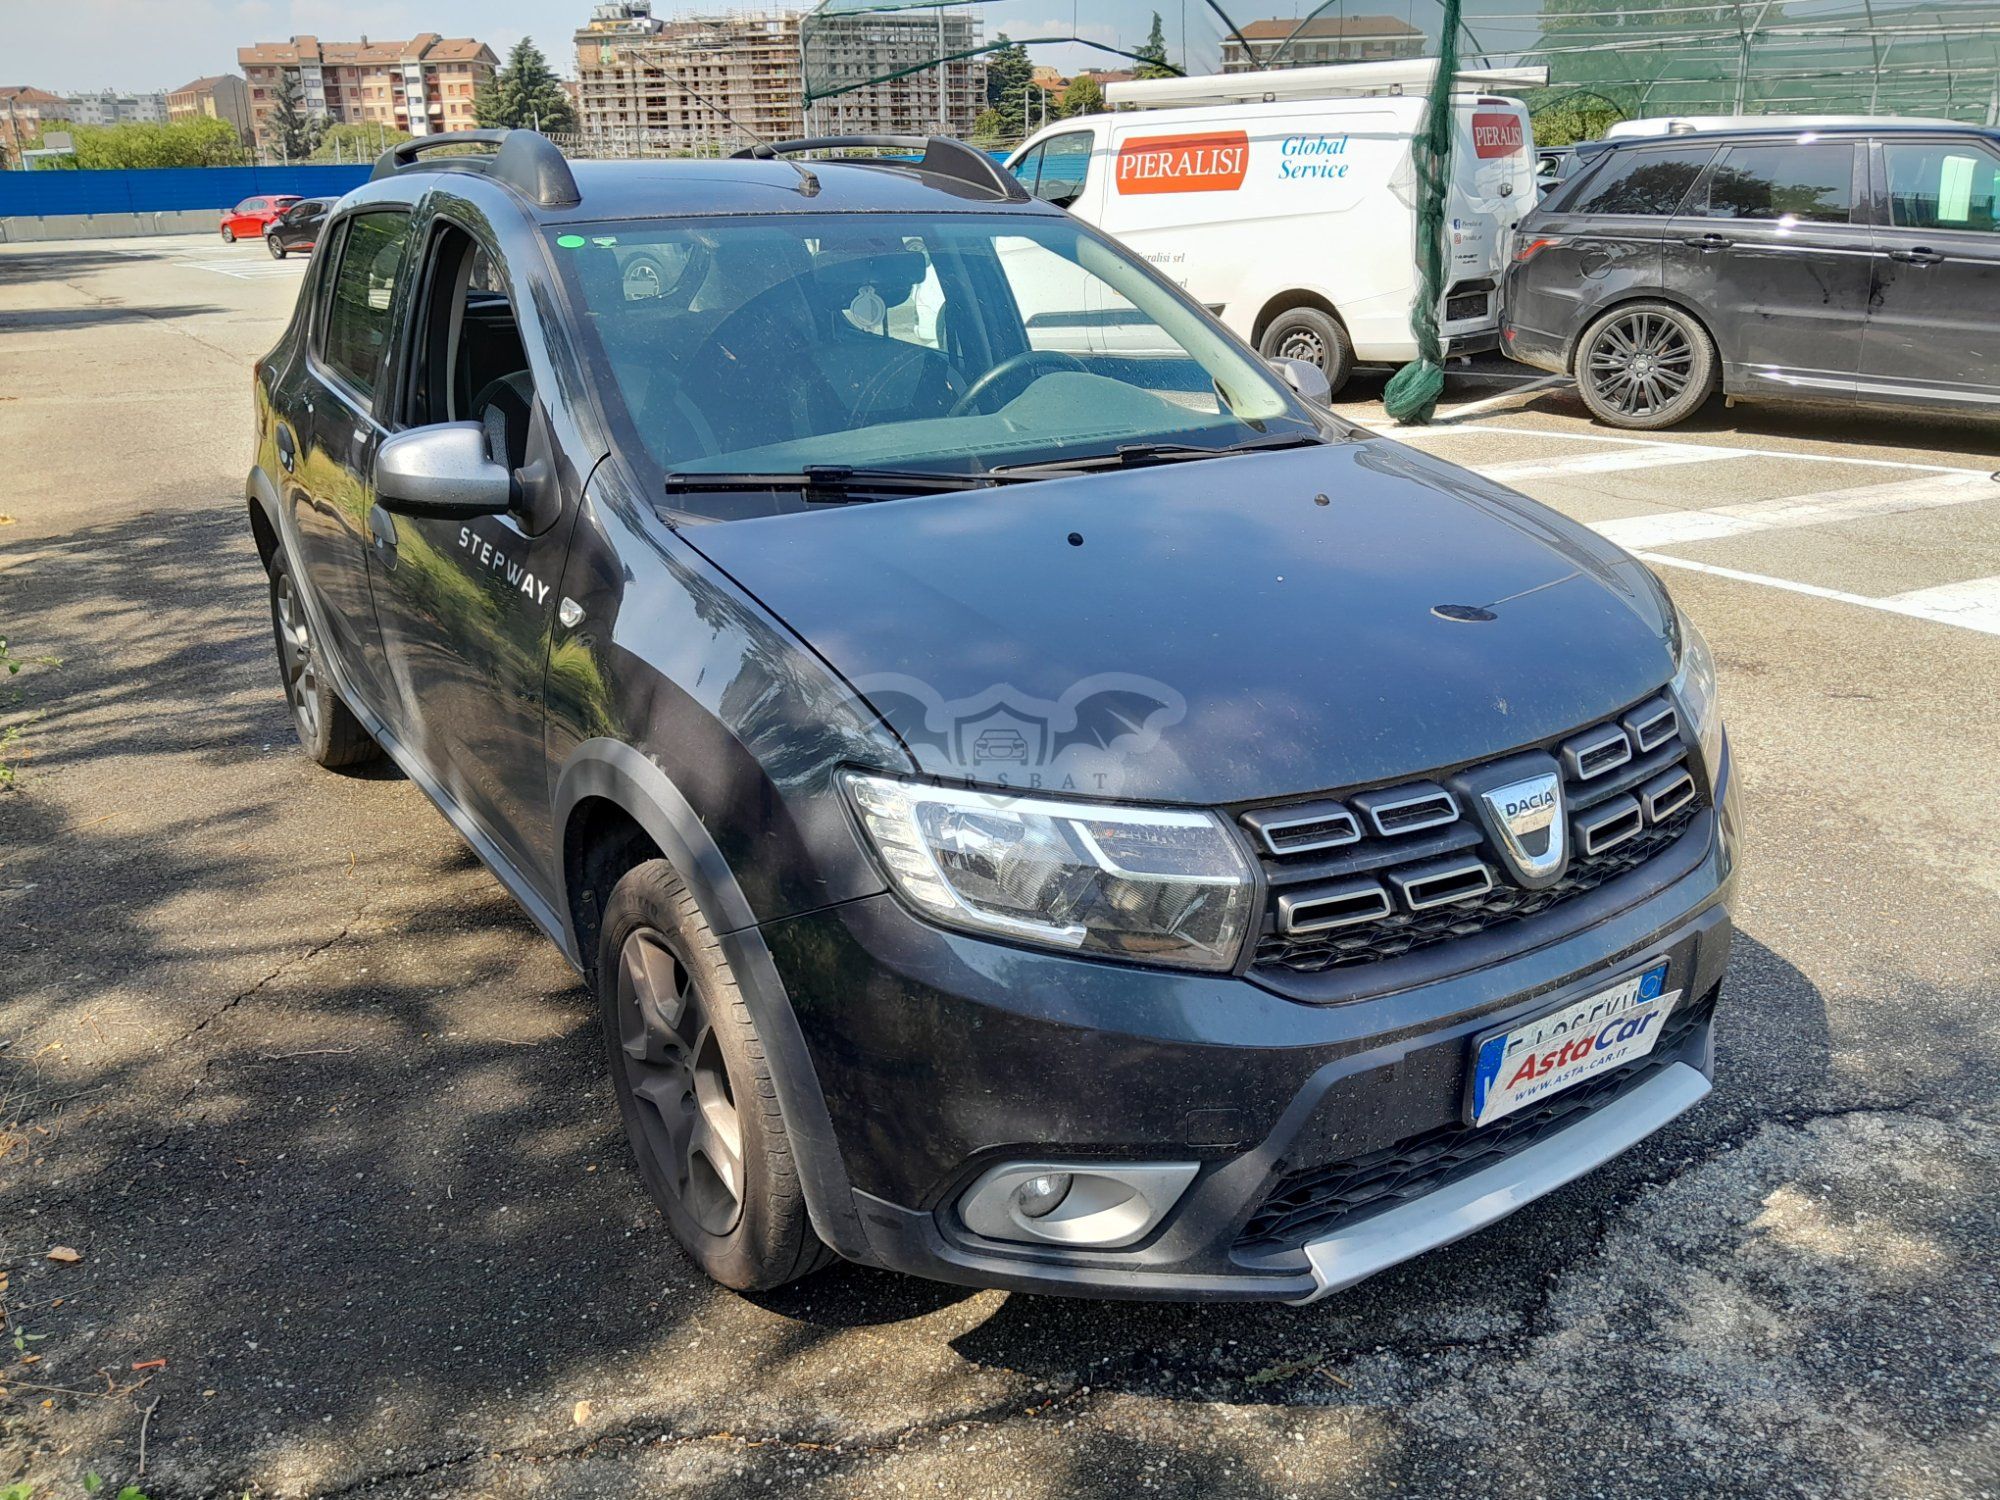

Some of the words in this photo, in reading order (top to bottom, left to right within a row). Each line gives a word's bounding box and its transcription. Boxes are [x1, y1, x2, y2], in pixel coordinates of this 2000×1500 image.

[1282, 134, 1349, 156] Global
[1475, 125, 1523, 147] PIERALISI
[1120, 147, 1244, 180] PIERALISI
[1279, 159, 1349, 180] Service
[458, 525, 550, 605] STEPWAY
[1505, 791, 1555, 816] DACIA
[1505, 1009, 1659, 1090] AstaCar
[1514, 1046, 1629, 1102] WWW.ASTA-CAR.IT
